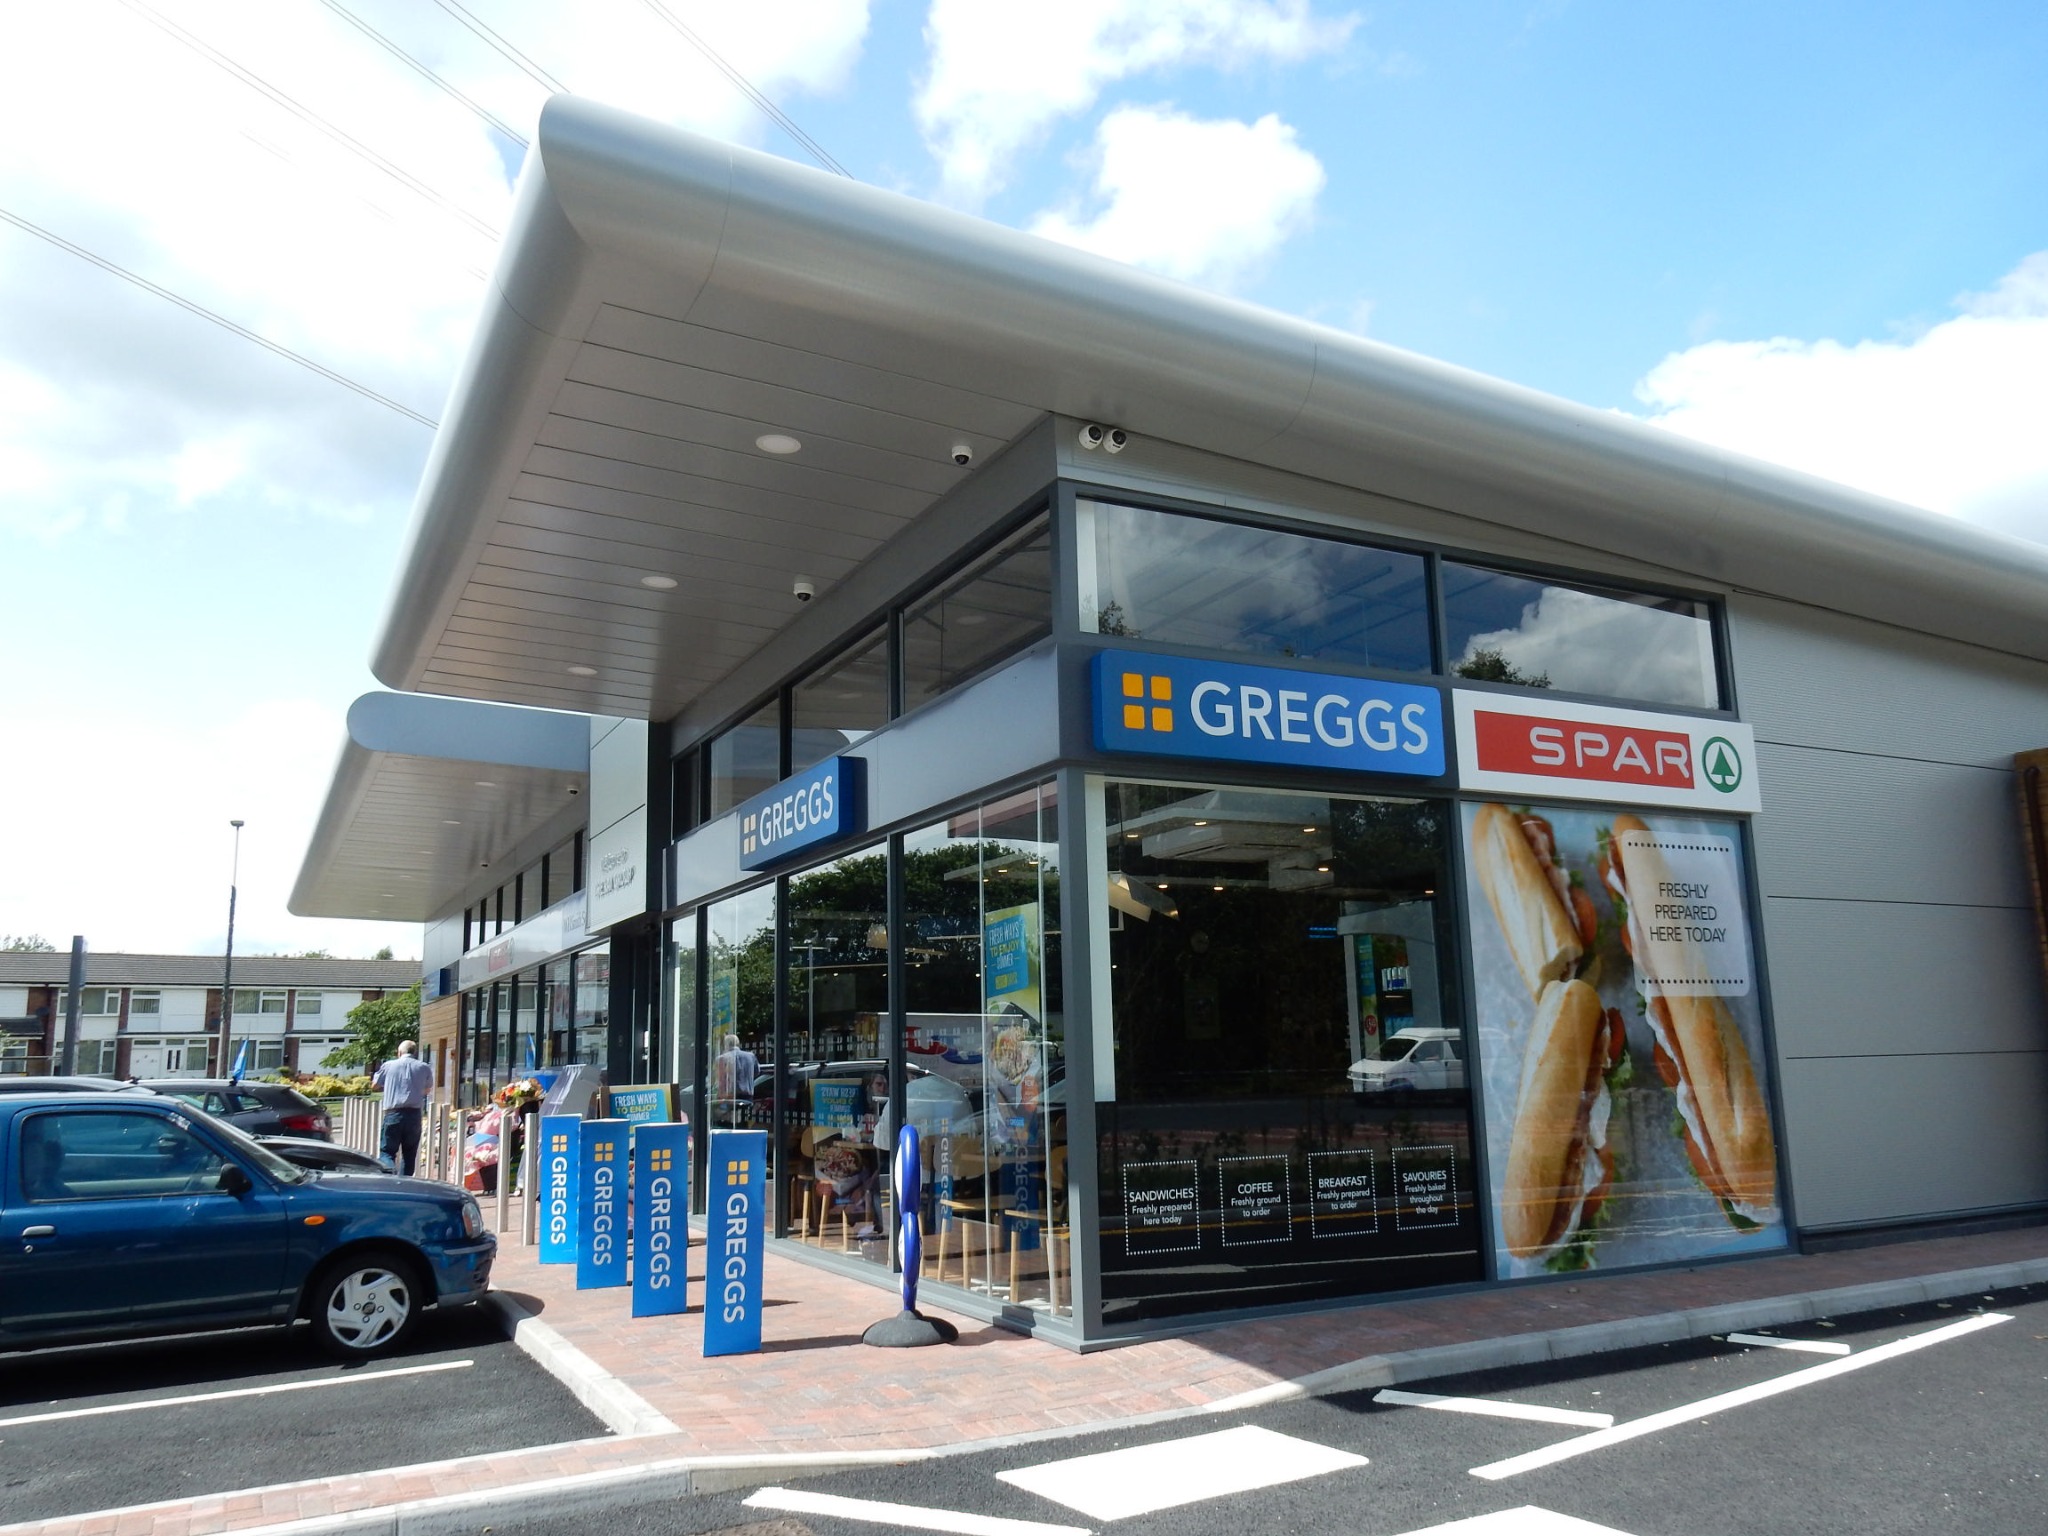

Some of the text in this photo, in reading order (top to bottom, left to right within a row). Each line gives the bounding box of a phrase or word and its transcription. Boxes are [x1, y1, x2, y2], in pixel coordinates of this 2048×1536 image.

[1190, 680, 1429, 755] GREGGS
[1530, 727, 1690, 780] SPAR
[760, 775, 833, 846] GREGGS
[1658, 882, 1709, 899] FRESHLY
[1654, 904, 1717, 921] PREPARED
[1004, 921, 1020, 941] WAYS
[1650, 926, 1727, 943] HERE TODAY
[614, 1092, 658, 1107] FRESH WAYS
[616, 1104, 658, 1115] TO ENJOY
[627, 1112, 650, 1121] SUMMER
[1318, 1175, 1368, 1189] BREAKFAST
[1402, 1169, 1447, 1183] SAVOURIES
[1237, 1181, 1274, 1194] COFFEE
[1316, 1187, 1370, 1201] Freshly prepared
[1404, 1182, 1447, 1194] Freshly baked
[551, 1156, 568, 1245] GREGGS
[1129, 1187, 1194, 1203] SANDWICHES
[1231, 1194, 1281, 1207] Freshly ground
[1409, 1194, 1443, 1205] throughout
[1132, 1201, 1192, 1215] Freshly prepared
[1243, 1207, 1271, 1217] to order
[1331, 1200, 1358, 1210] to order
[1415, 1204, 1439, 1215] the day
[593, 1166, 614, 1266] GREGGS
[1143, 1214, 1182, 1226] here today
[650, 1177, 672, 1290] GREGGS
[723, 1192, 749, 1324] GREGGS
